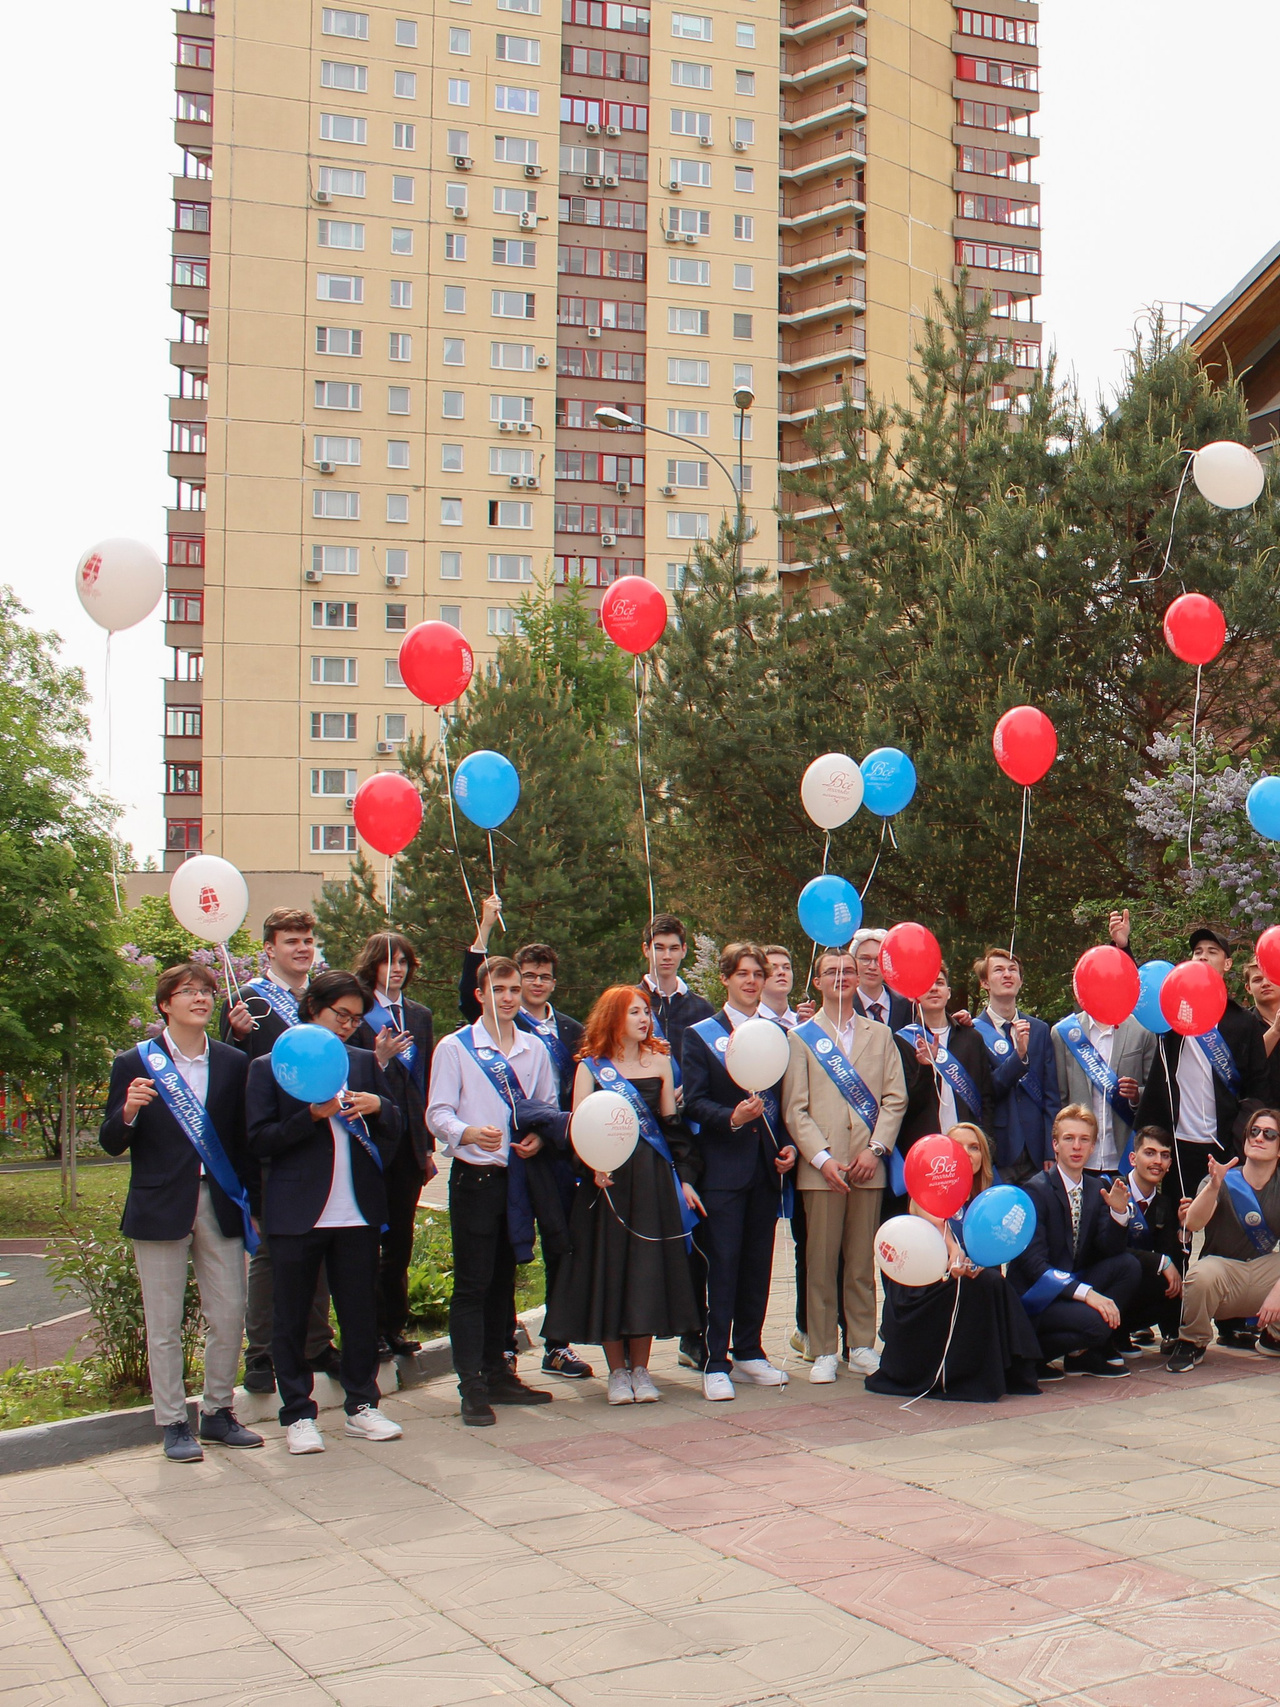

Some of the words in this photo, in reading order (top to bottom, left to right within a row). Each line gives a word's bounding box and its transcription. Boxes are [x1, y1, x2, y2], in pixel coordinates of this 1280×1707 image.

[608, 599, 637, 617] Всё
[822, 771, 855, 790] Всё
[866, 761, 895, 776] Всё
[263, 983, 300, 1024] Выпускн
[1077, 1044, 1115, 1093] Выпускник
[1203, 1032, 1232, 1080] Выпускни
[160, 1072, 206, 1137] Выпускник
[827, 1055, 871, 1109] Выпускник
[863, 1105, 879, 1125] 202
[605, 1107, 634, 1125] Всё
[925, 1155, 957, 1176] Всё
